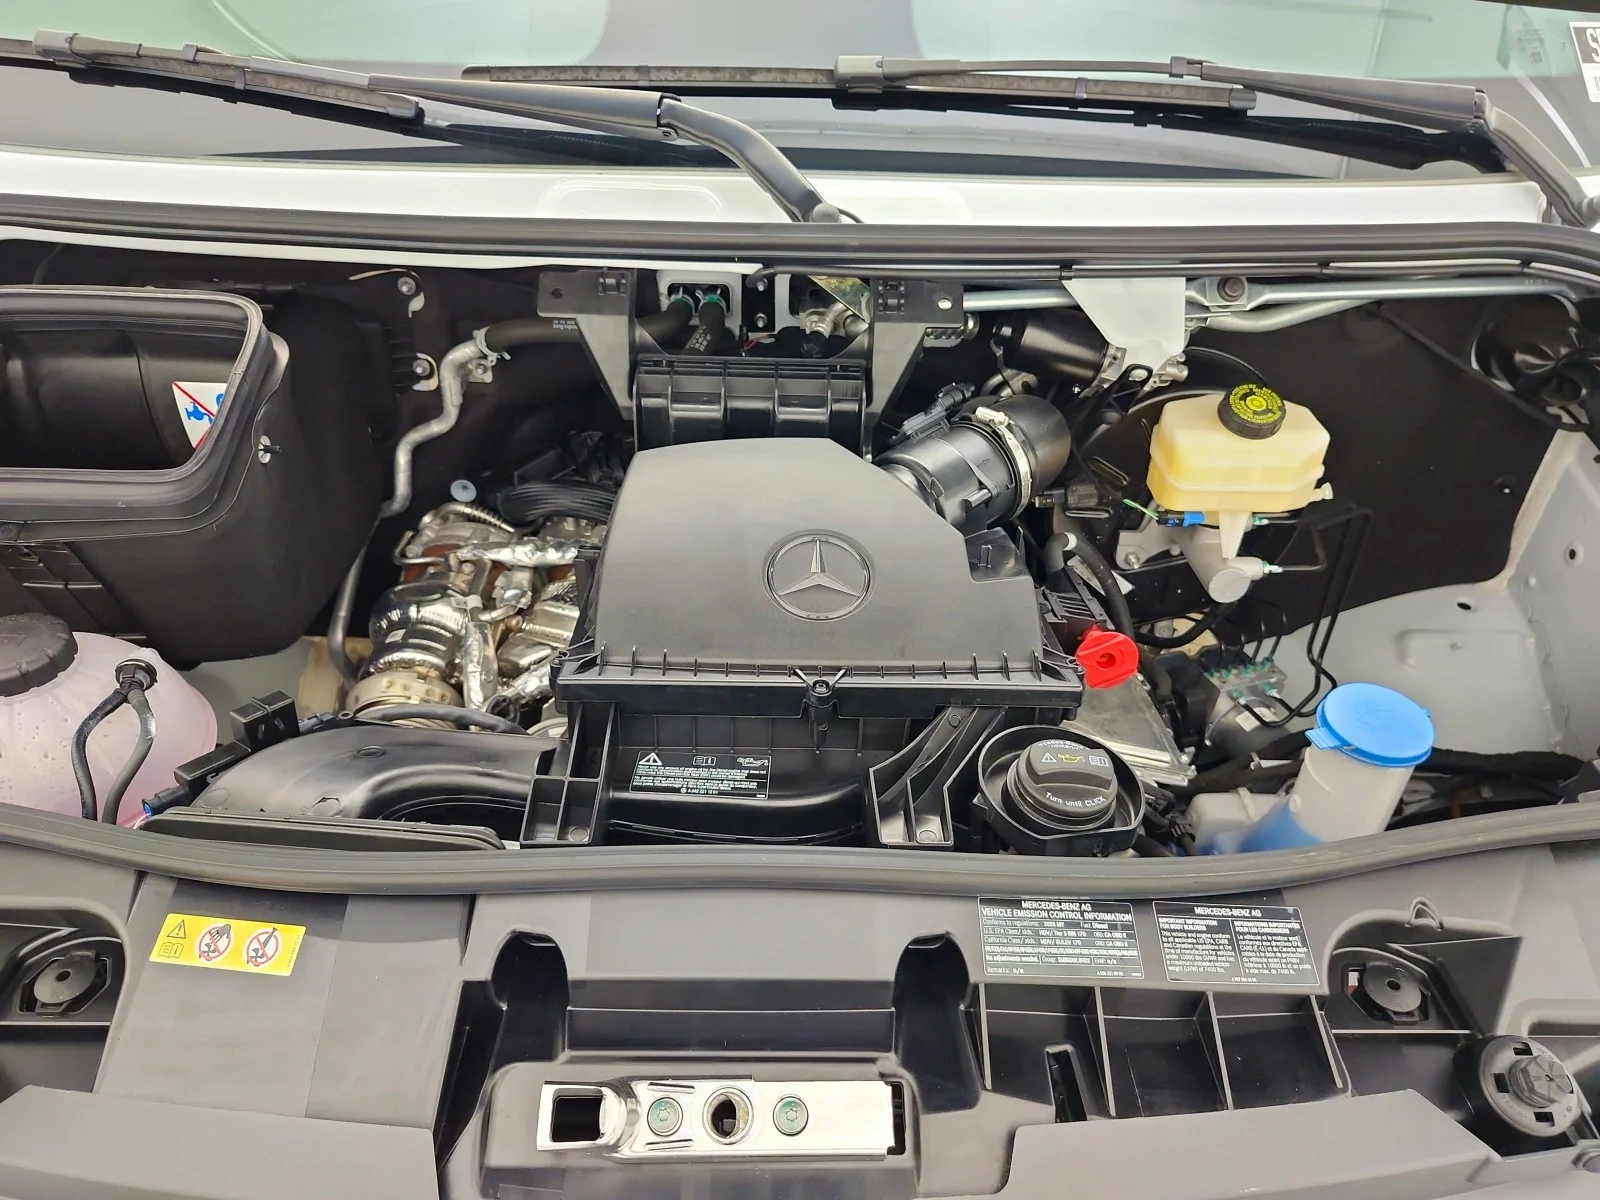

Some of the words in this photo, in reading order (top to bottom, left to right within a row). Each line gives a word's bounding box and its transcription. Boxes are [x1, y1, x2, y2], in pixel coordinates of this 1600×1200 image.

[1586, 28, 1600, 62] S
[1046, 791, 1062, 804] Turn
[1084, 796, 1106, 806] CLICK
[1022, 901, 1080, 910] MERCEDES-BENZ
[1081, 903, 1092, 912] AG
[1194, 907, 1250, 916] MERCEDES-BENZ
[982, 908, 1012, 917] VEHICLE
[1013, 909, 1048, 919] EMISSION
[1049, 911, 1083, 920] CONTROL
[1084, 912, 1132, 922] INFORMATION
